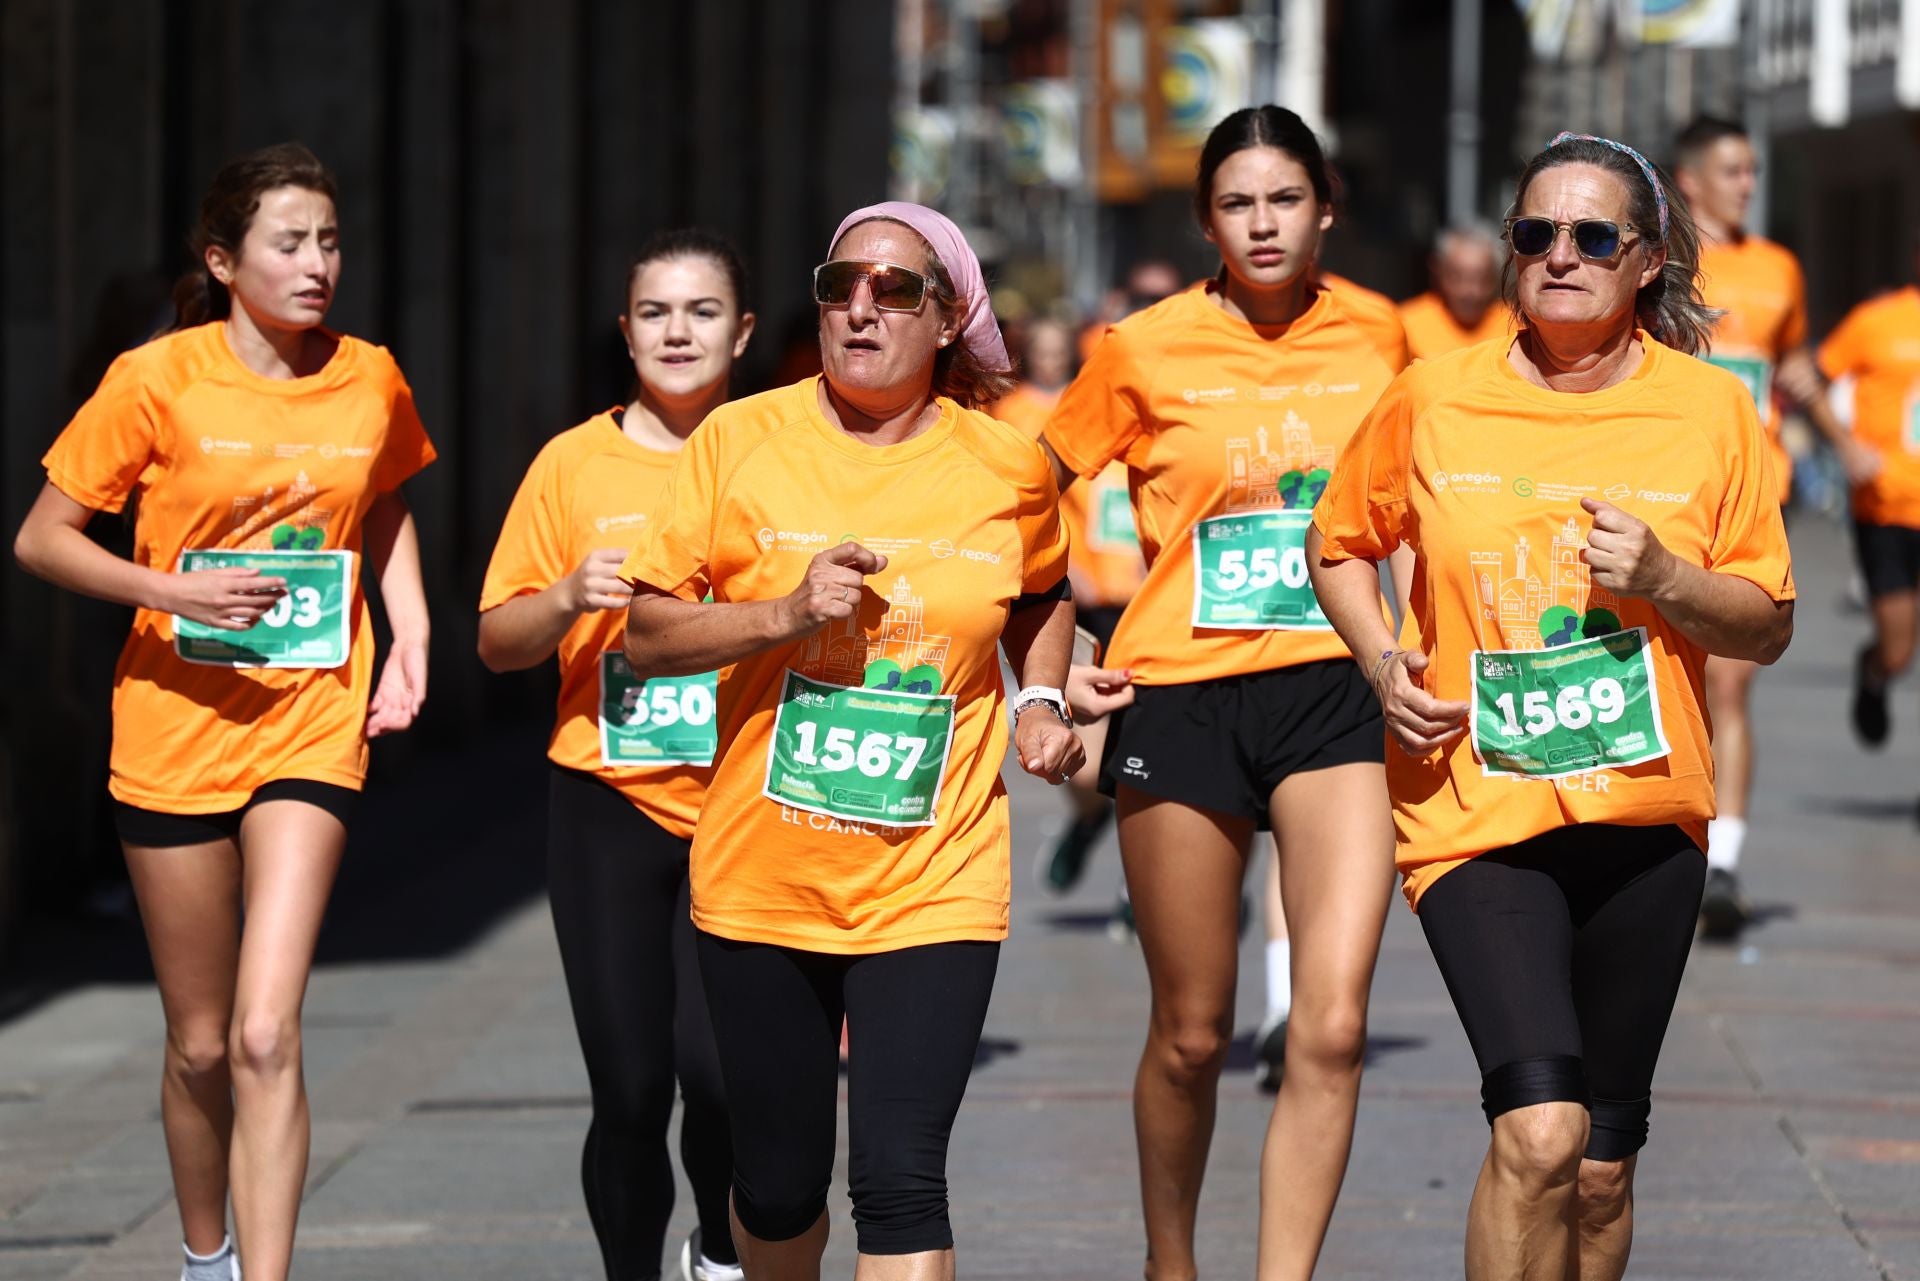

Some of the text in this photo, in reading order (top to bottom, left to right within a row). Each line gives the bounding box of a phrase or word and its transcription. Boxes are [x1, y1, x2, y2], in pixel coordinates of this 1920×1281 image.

[1450, 472, 1501, 485] oregón
[1636, 490, 1690, 504] repsol
[777, 530, 828, 545] oregón
[777, 545, 825, 553] comercia
[960, 547, 1001, 564] repsol
[1216, 547, 1314, 591] 550
[622, 684, 716, 727] 550
[1495, 677, 1626, 736] 1569
[793, 720, 928, 781] 1567
[782, 805, 802, 826] EL
